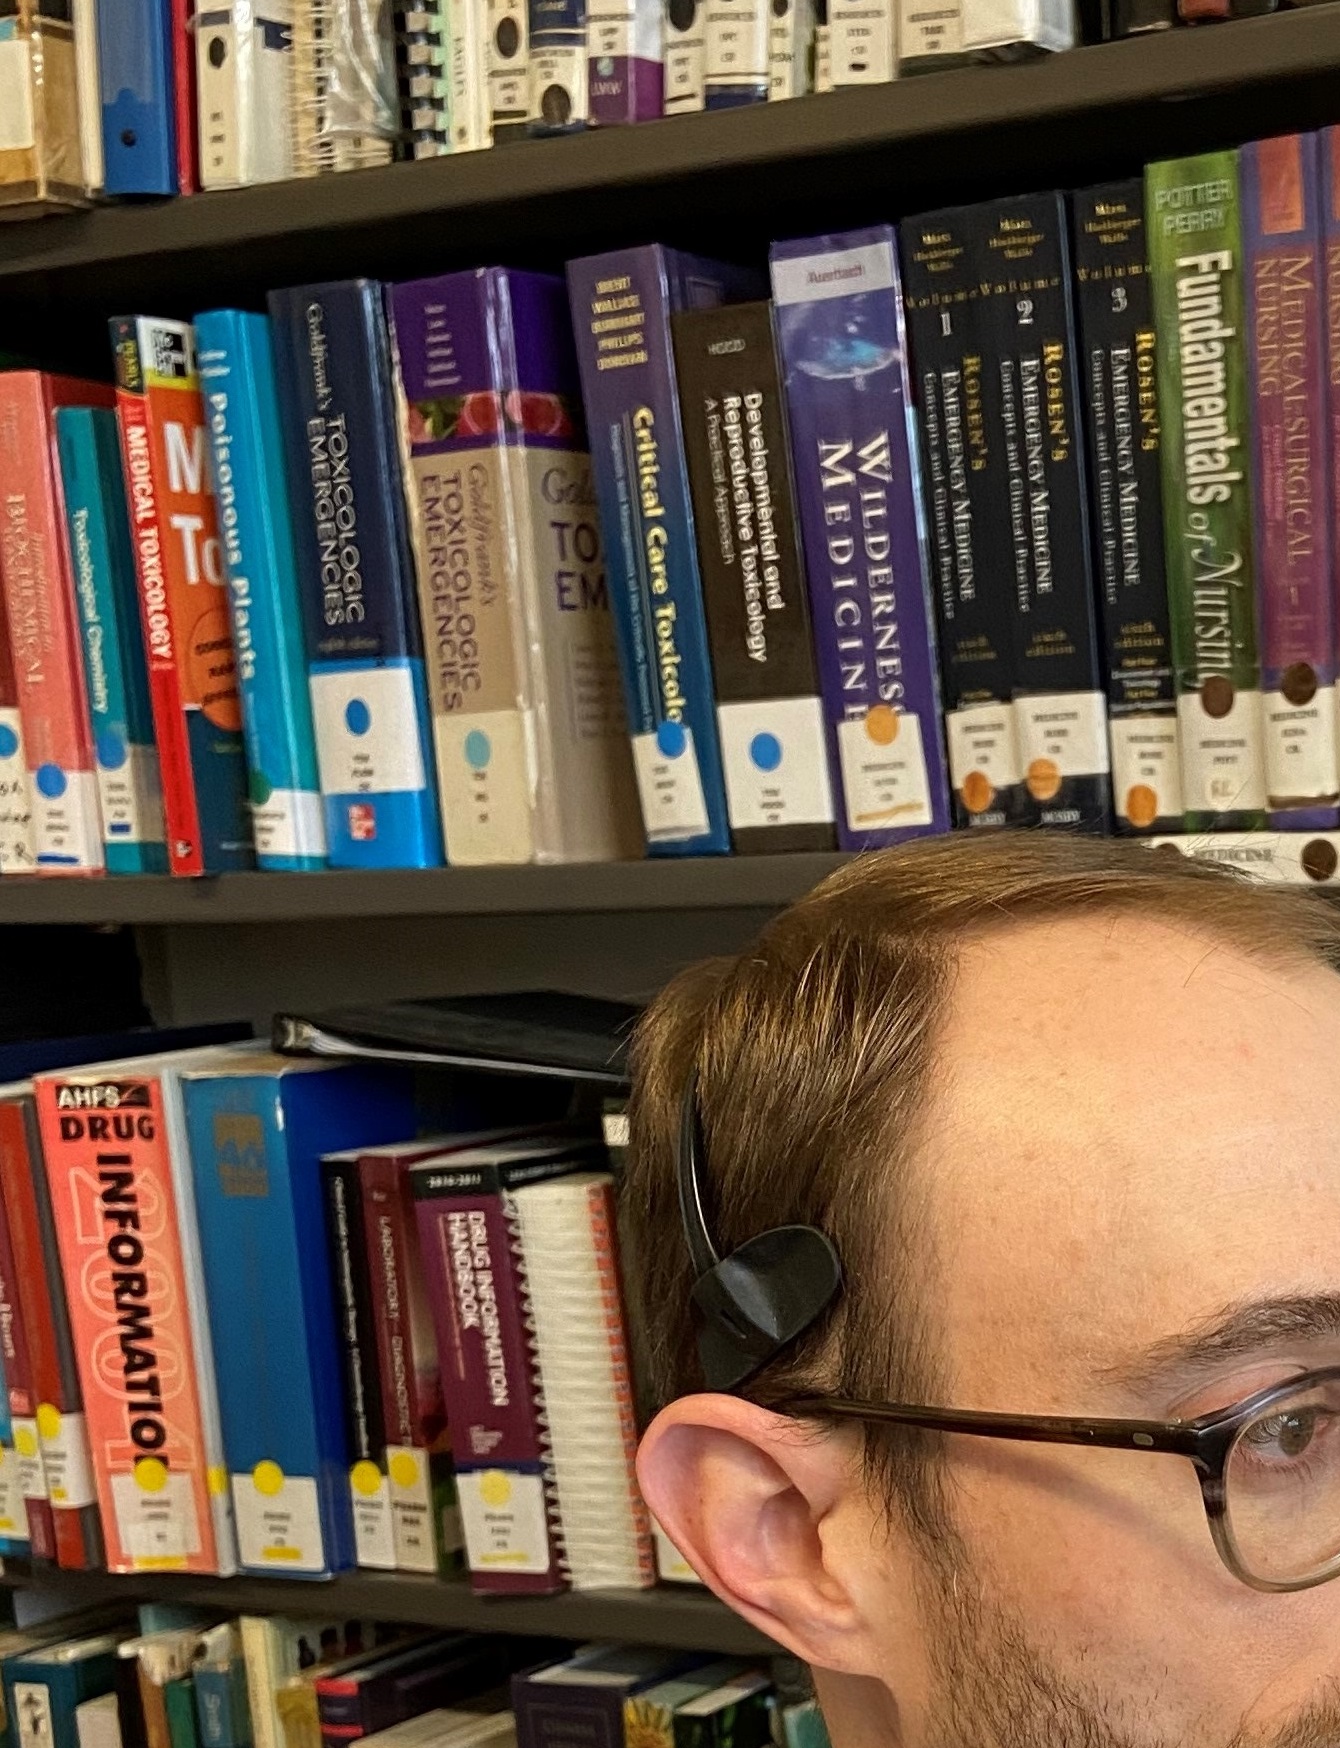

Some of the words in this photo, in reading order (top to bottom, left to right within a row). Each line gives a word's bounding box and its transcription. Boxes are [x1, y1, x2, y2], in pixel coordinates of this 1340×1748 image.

[1154, 178, 1234, 213] POTTER
[940, 311, 952, 337] 1
[1016, 299, 1034, 325] 2
[1111, 286, 1128, 313] 3
[1255, 259, 1283, 398] NURSING
[941, 370, 966, 496] EMERGENCY
[1020, 359, 1046, 487] EMERGENCY
[1111, 348, 1137, 478] EMERGENCY
[1175, 250, 1245, 505] Fundamentals
[127, 424, 155, 523] MEDICAL
[307, 419, 344, 626] EMERGENCIES
[326, 413, 365, 623] TOXICOLOGIC
[632, 406, 666, 519] Critical
[744, 392, 781, 562] Developmental
[765, 565, 786, 610] and
[208, 392, 244, 565] Poisonous
[231, 576, 257, 680] Plants
[443, 471, 481, 692] TOXICOLOGIC
[646, 525, 669, 596] Care
[722, 395, 755, 543] Reproductive
[739, 544, 767, 663] Toxicology
[951, 497, 976, 601] MEDICINE
[1031, 487, 1053, 595] MEDICINE
[1119, 481, 1142, 587] MEDICINE
[1184, 512, 1218, 549] of
[73, 507, 101, 623] Toxicological
[87, 624, 108, 714] Chemistry
[139, 528, 172, 659] TOXICOLOGY
[422, 474, 463, 712] EMERGENCIES
[655, 600, 687, 722] Toxicolo
[60, 1114, 154, 1141] DRUG
[447, 1212, 480, 1329] HANDBOOK
[468, 1211, 492, 1269] DRUG
[475, 1269, 510, 1406] INFORMATION
